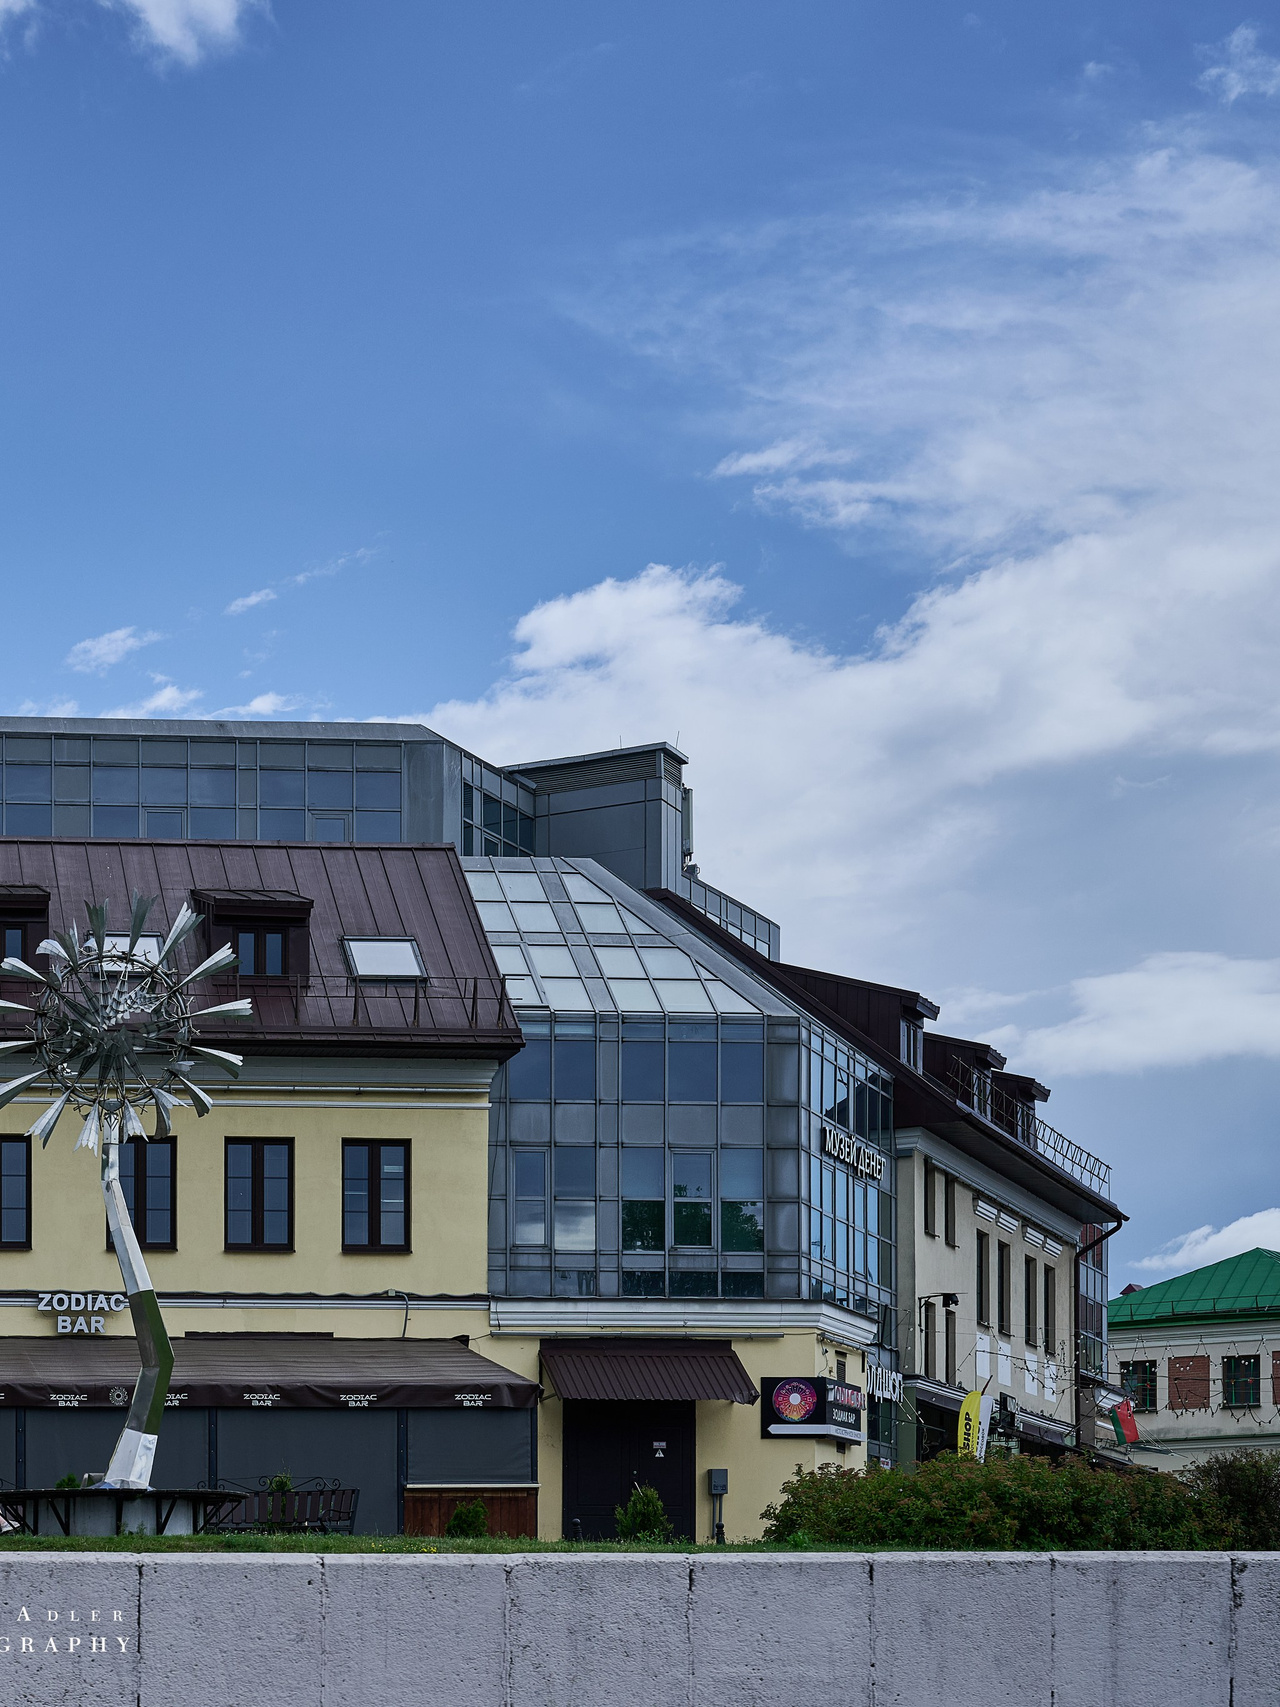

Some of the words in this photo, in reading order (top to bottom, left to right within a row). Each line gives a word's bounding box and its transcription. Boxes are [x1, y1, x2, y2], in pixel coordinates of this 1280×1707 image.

[825, 1126, 857, 1167] МУЗЕЙ
[857, 1146, 887, 1180] ДЕНЕГ
[37, 1293, 126, 1312] ZODIAC
[57, 1316, 106, 1334] BAR
[962, 1411, 973, 1451] SHOP
